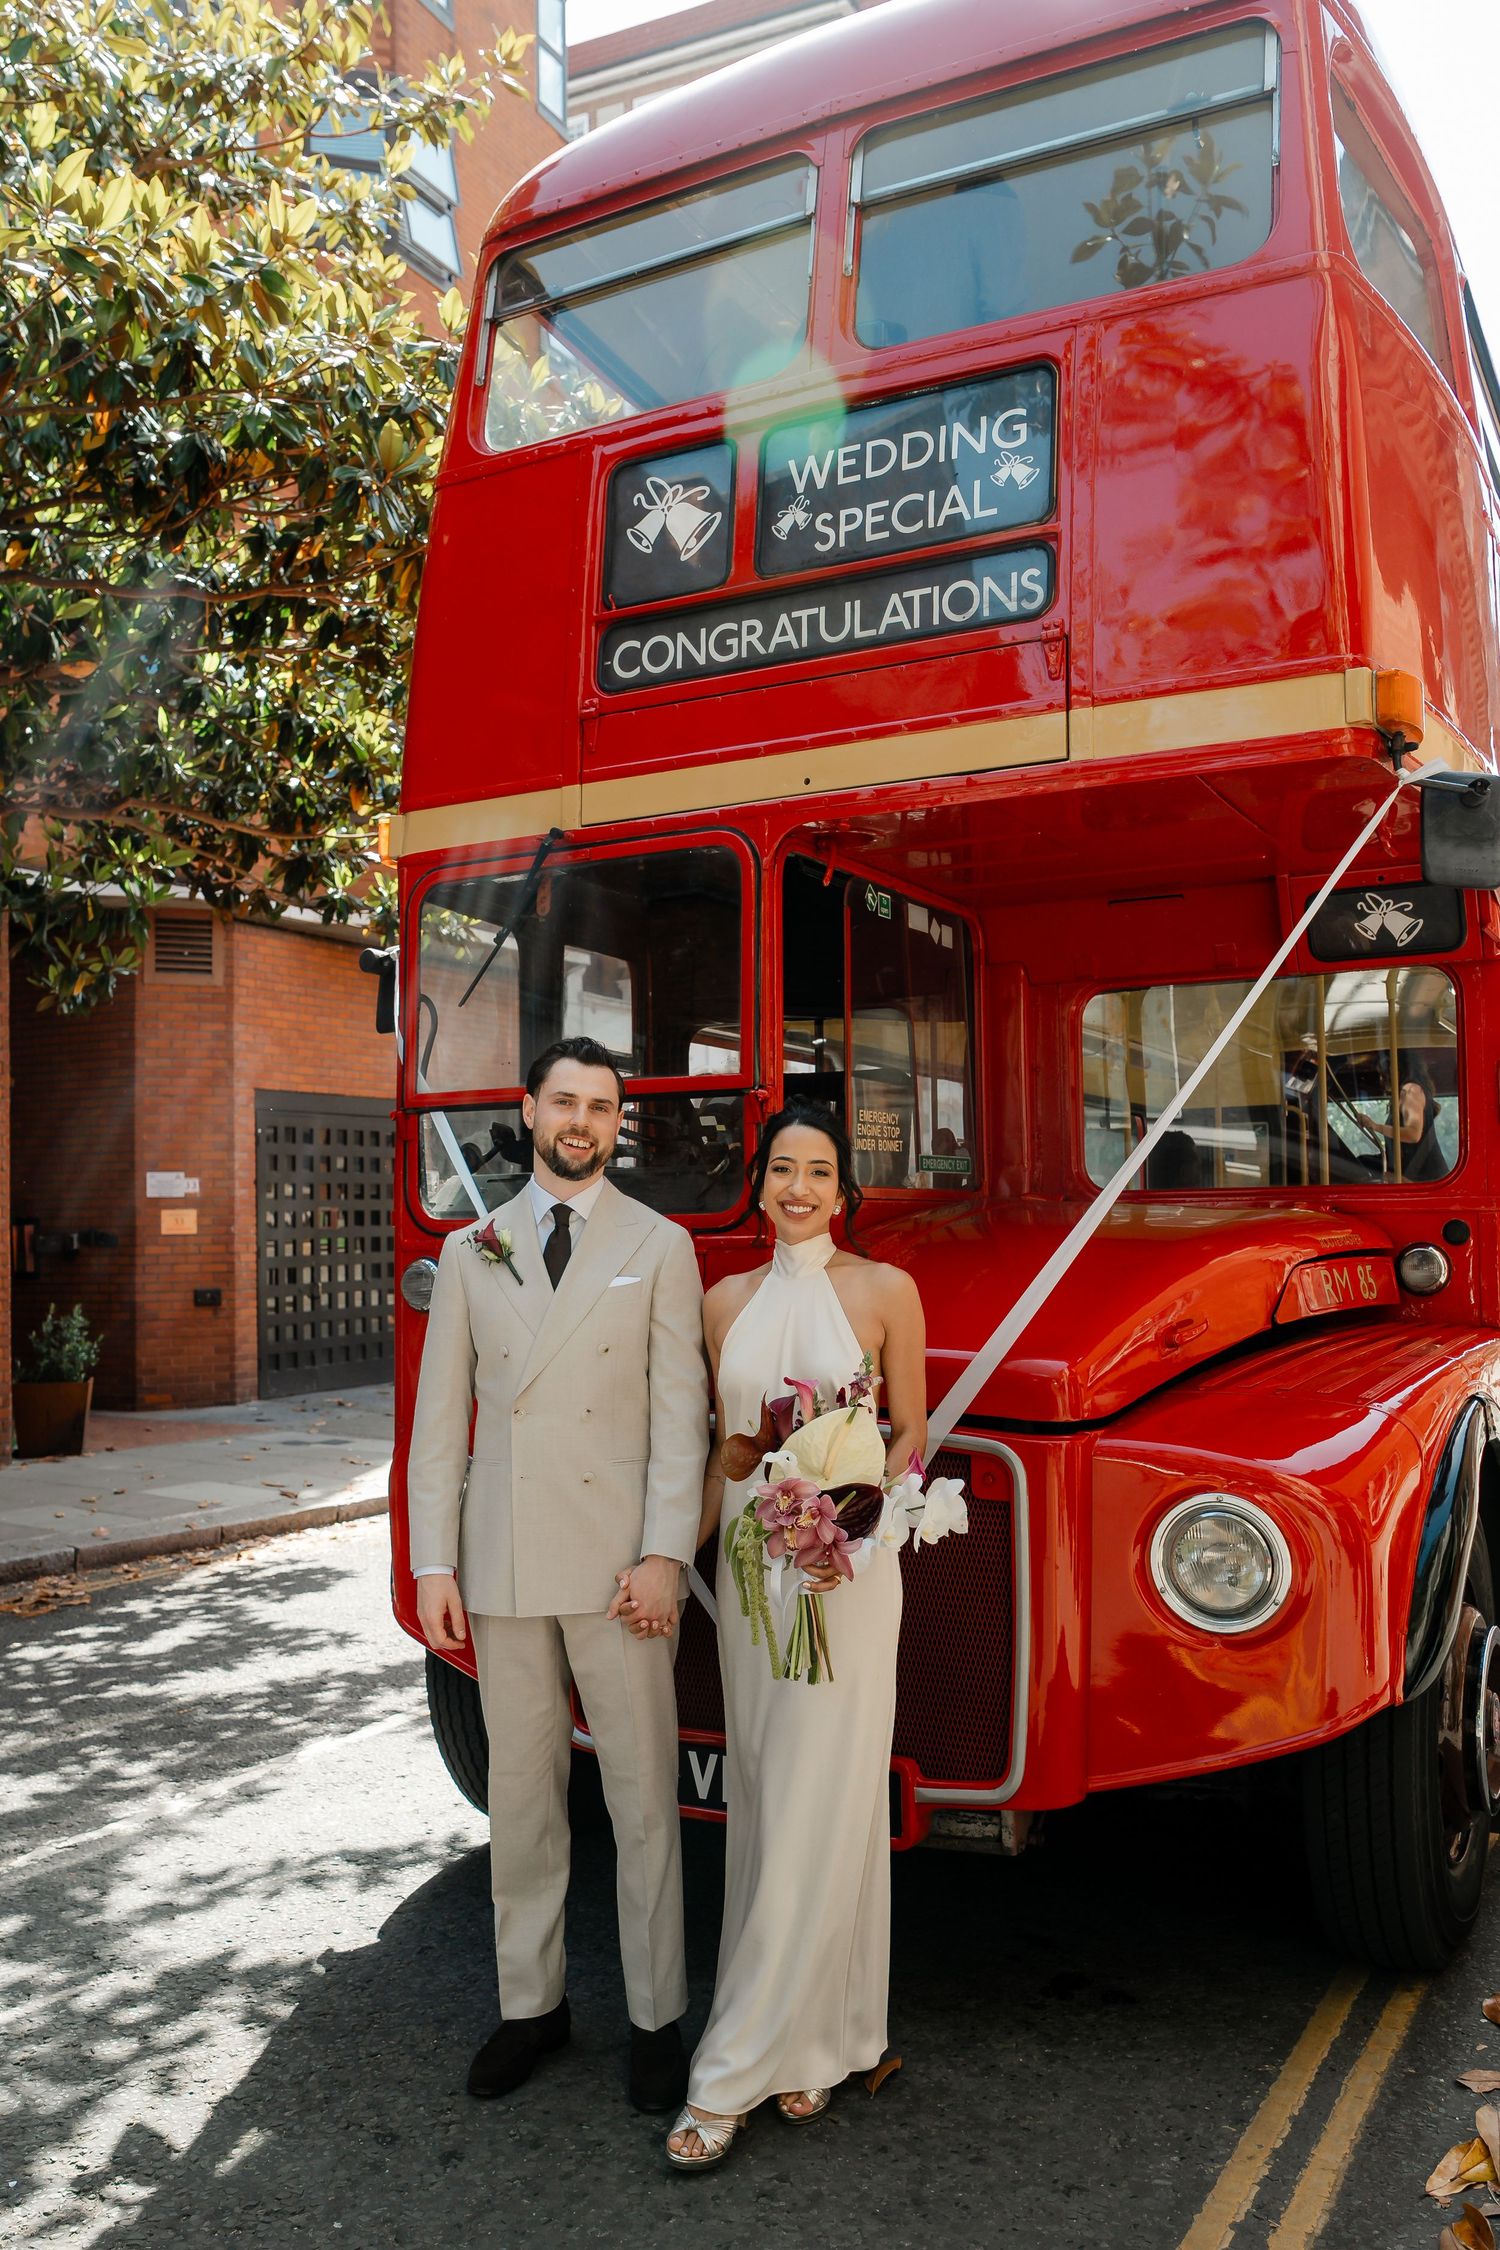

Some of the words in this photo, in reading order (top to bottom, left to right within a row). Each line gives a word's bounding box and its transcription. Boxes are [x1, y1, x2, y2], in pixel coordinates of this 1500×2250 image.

[788, 408, 1028, 493] WEDDING
[814, 479, 998, 553] SPECIAL
[612, 568, 1044, 679] CONGRATULATIONS
[857, 1124, 881, 1137] ENGINE
[882, 1126, 900, 1138] STOP
[859, 1109, 899, 1124] EMERGENCY
[854, 1138, 876, 1151] UNDER
[878, 1140, 903, 1152] BONNET
[922, 1158, 955, 1170] EMERGENCY
[956, 1160, 968, 1171] EXIT
[1320, 1267, 1355, 1305] RM
[1357, 1264, 1377, 1300] 85
[687, 1750, 728, 1803] V
